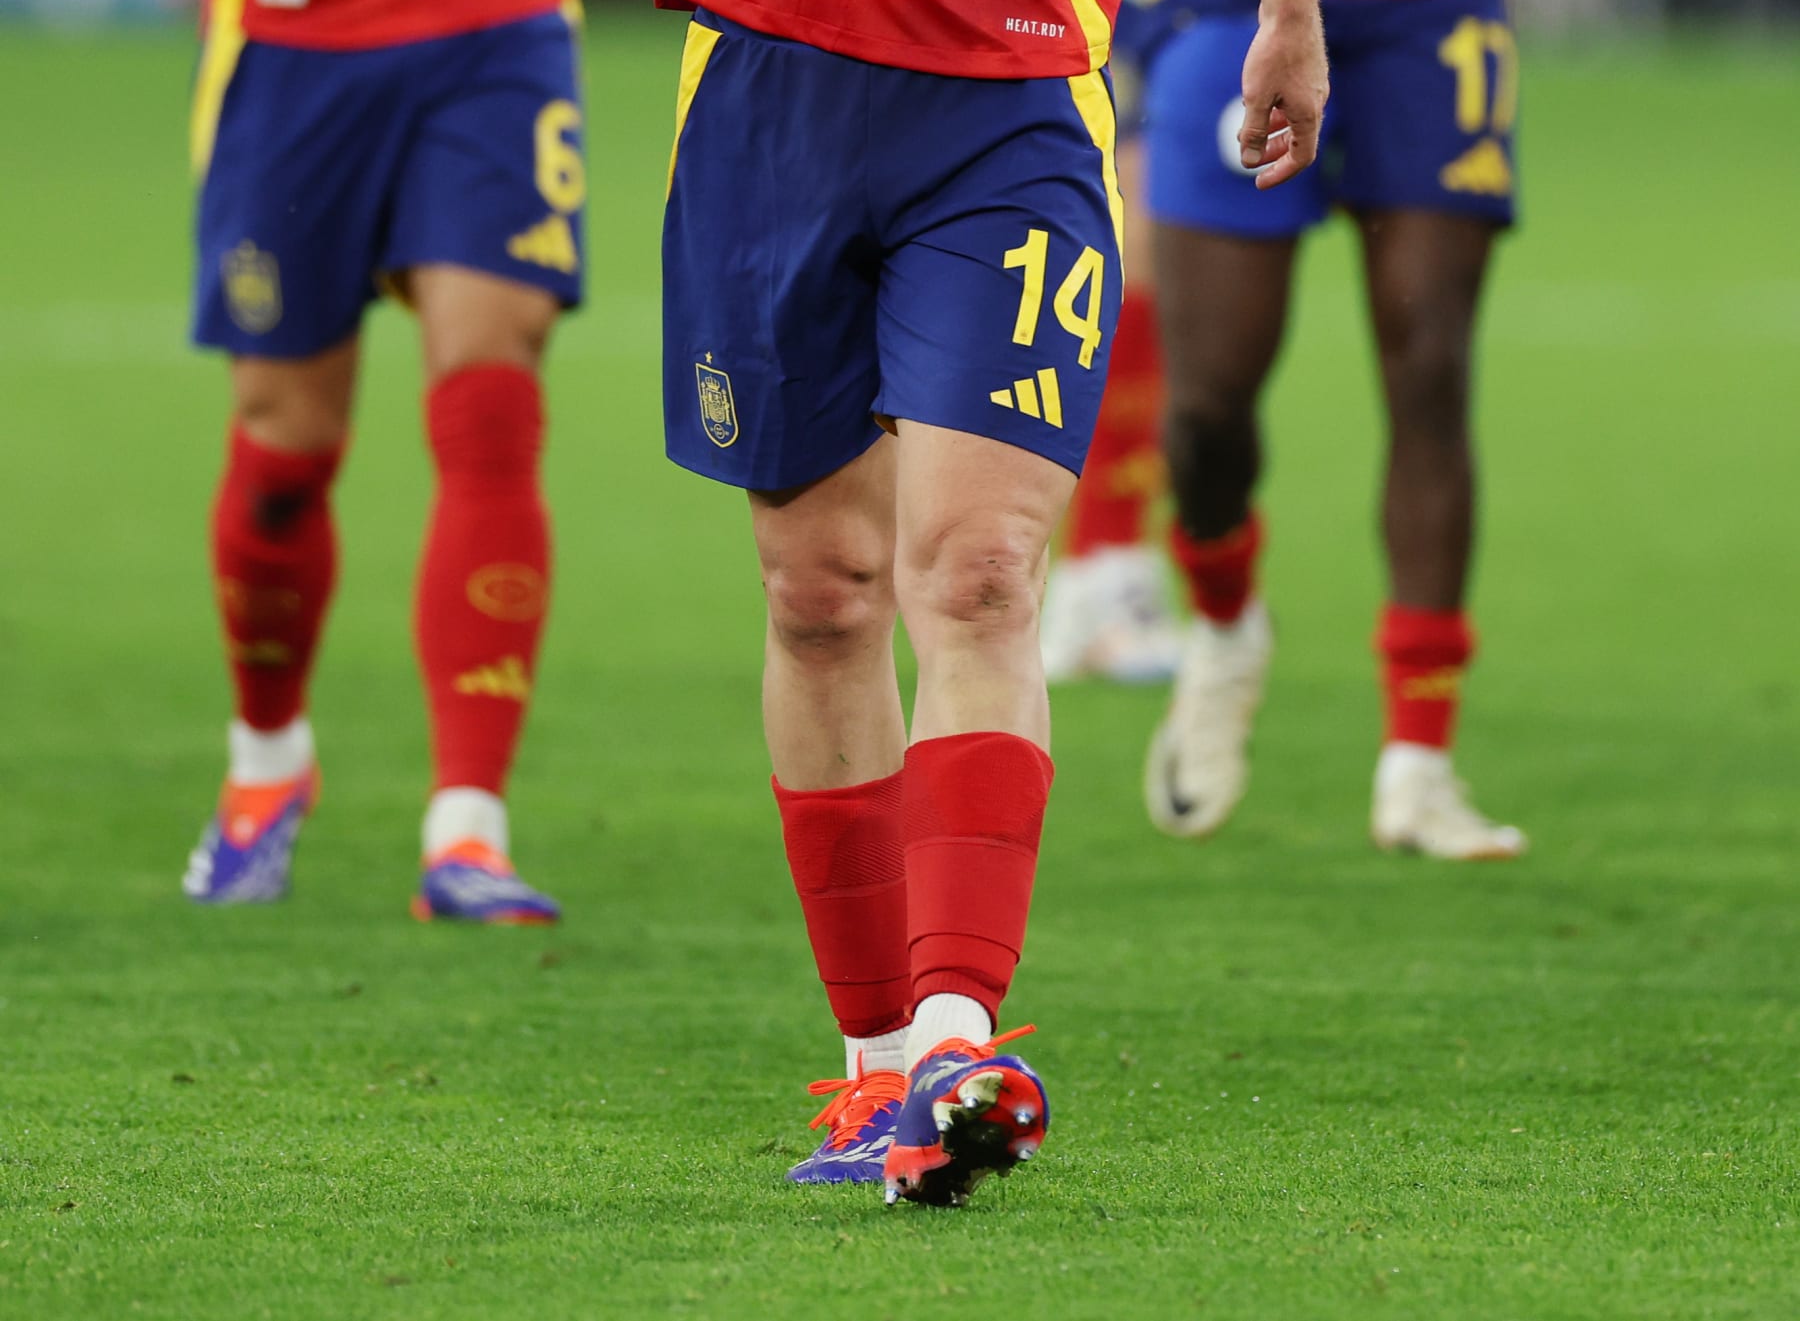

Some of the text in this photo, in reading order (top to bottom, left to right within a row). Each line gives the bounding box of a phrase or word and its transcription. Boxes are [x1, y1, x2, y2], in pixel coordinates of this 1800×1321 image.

[1005, 17, 1066, 39] HEAT.RDY
[533, 98, 587, 214] 6
[1003, 228, 1105, 371] 14
